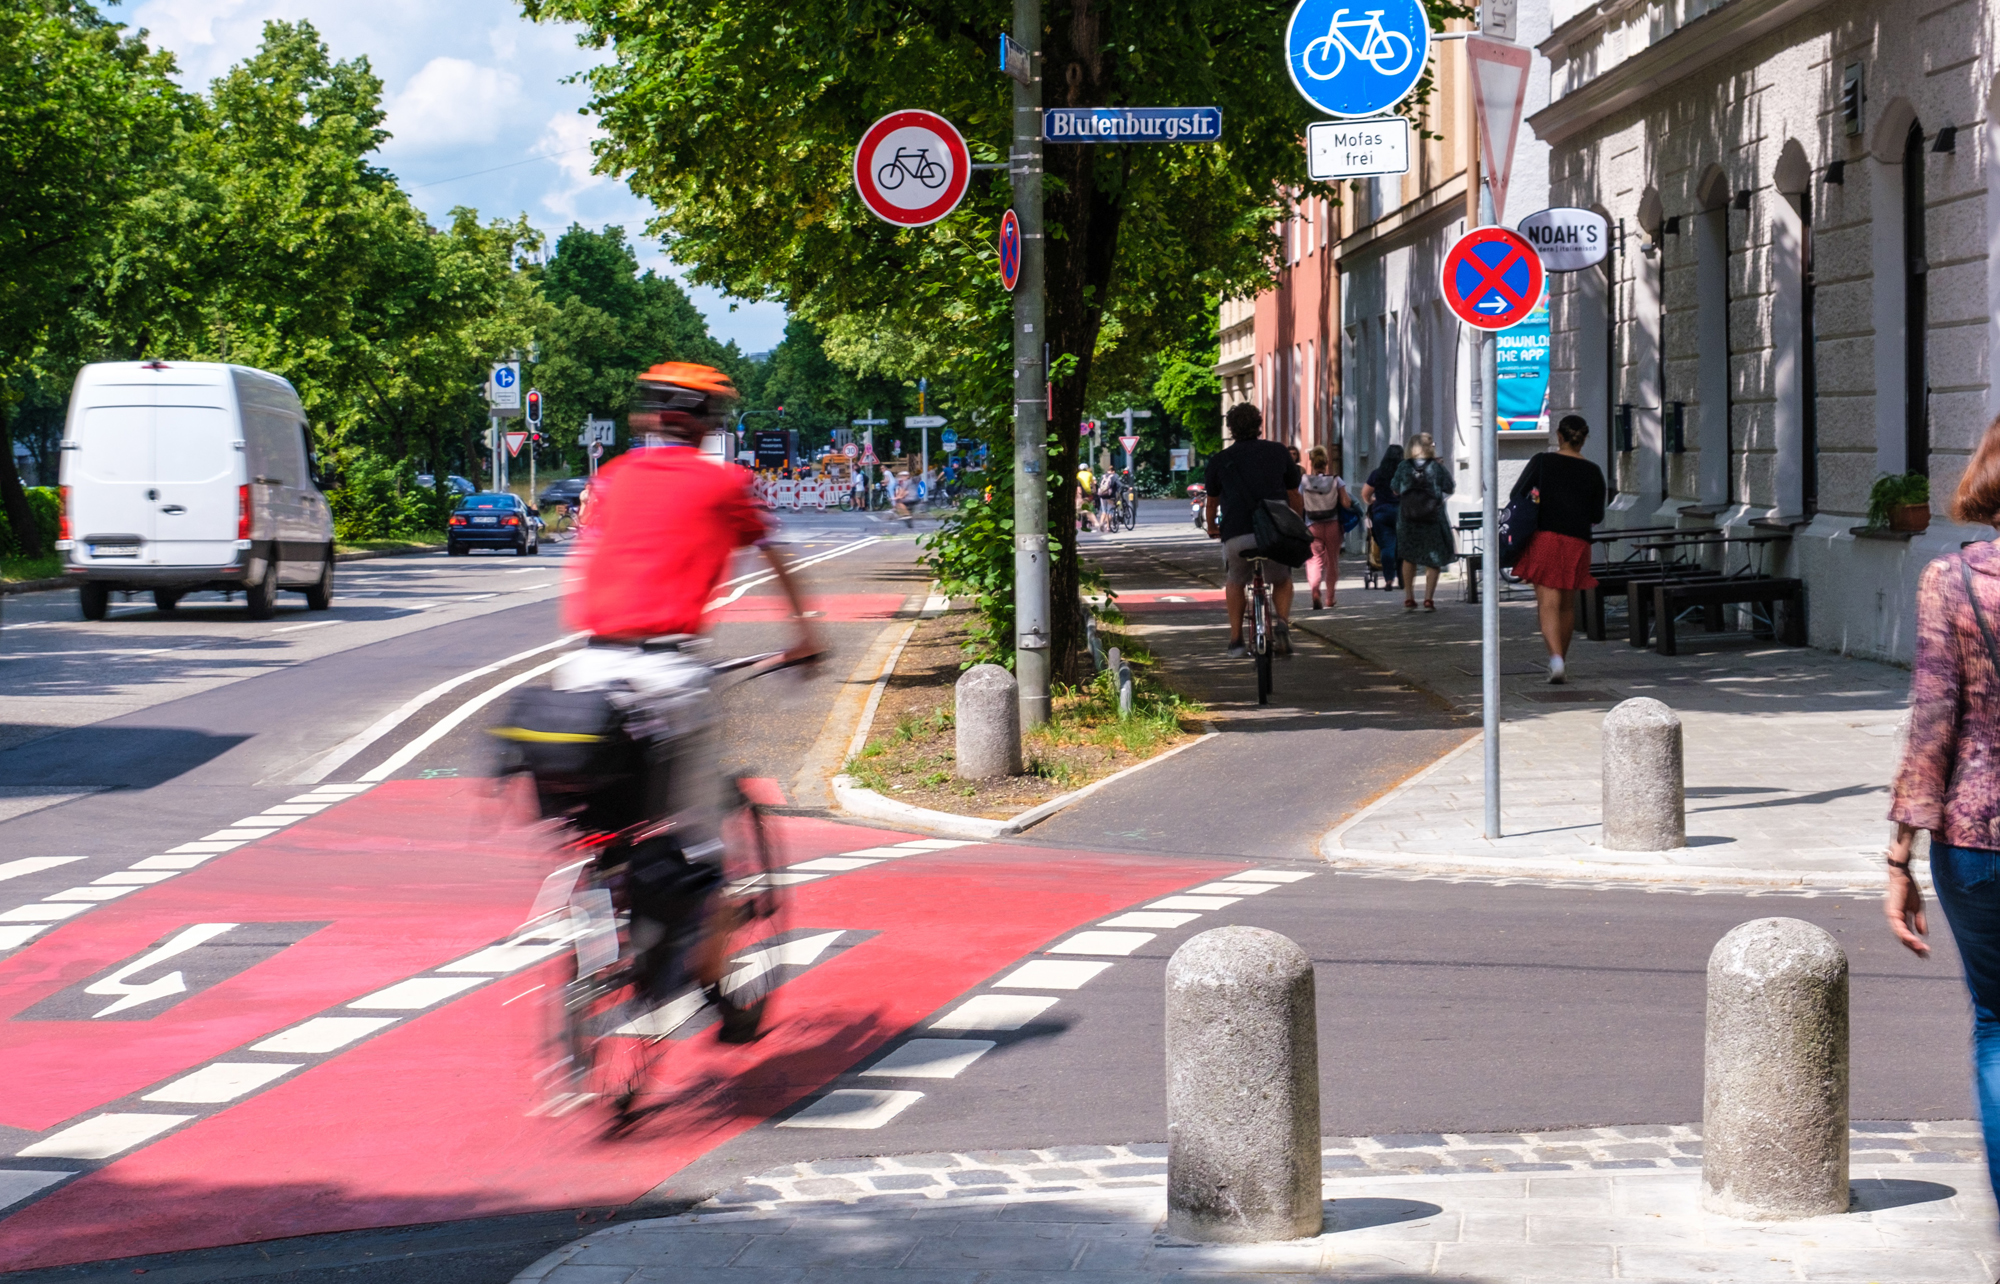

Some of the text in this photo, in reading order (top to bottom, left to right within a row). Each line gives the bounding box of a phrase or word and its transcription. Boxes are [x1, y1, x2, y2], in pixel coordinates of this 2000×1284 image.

[1053, 112, 1215, 140] Blutenburgstr.
[1334, 131, 1383, 148] Mofas
[1345, 151, 1374, 166] frei
[1527, 224, 1598, 244] NOAH'S
[1497, 348, 1545, 363] THE APP
[845, 447, 856, 455] 30
